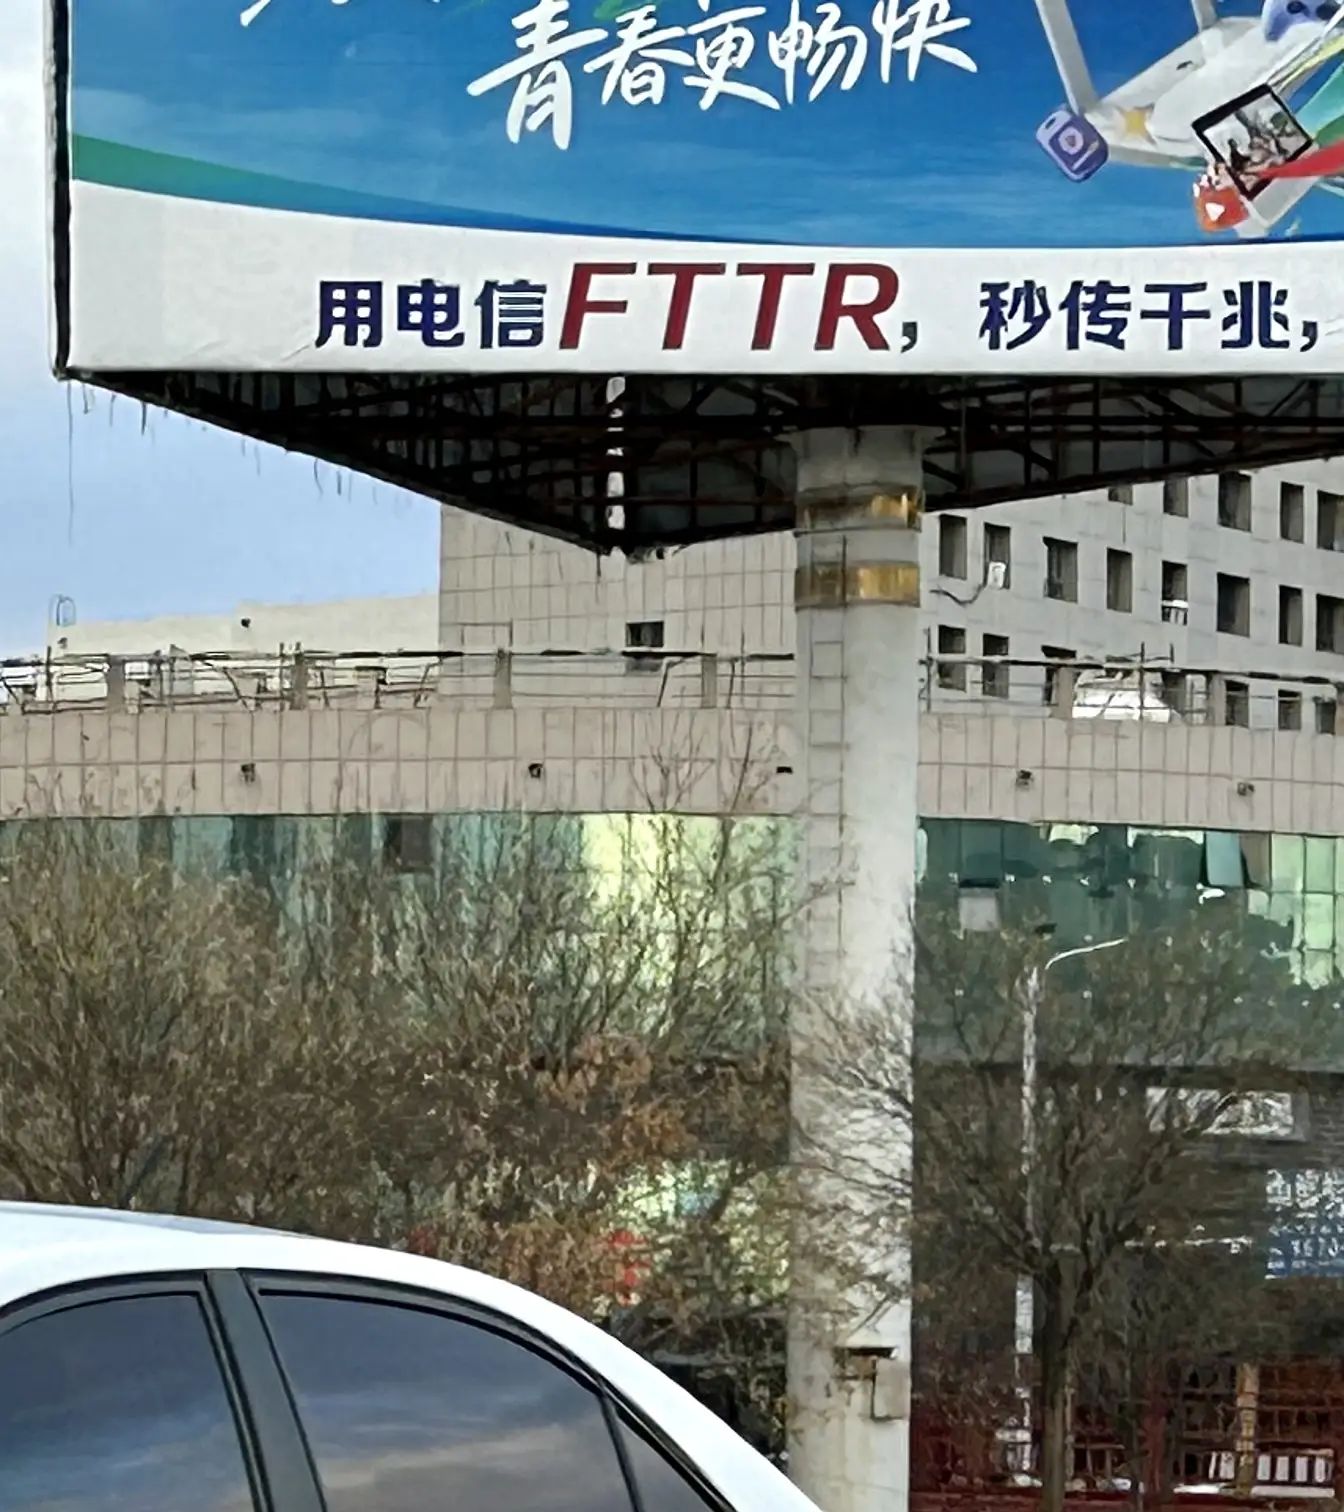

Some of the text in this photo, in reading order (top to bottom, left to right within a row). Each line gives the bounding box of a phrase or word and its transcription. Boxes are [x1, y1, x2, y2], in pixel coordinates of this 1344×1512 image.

[466, 0, 979, 150] 青春更畅快
